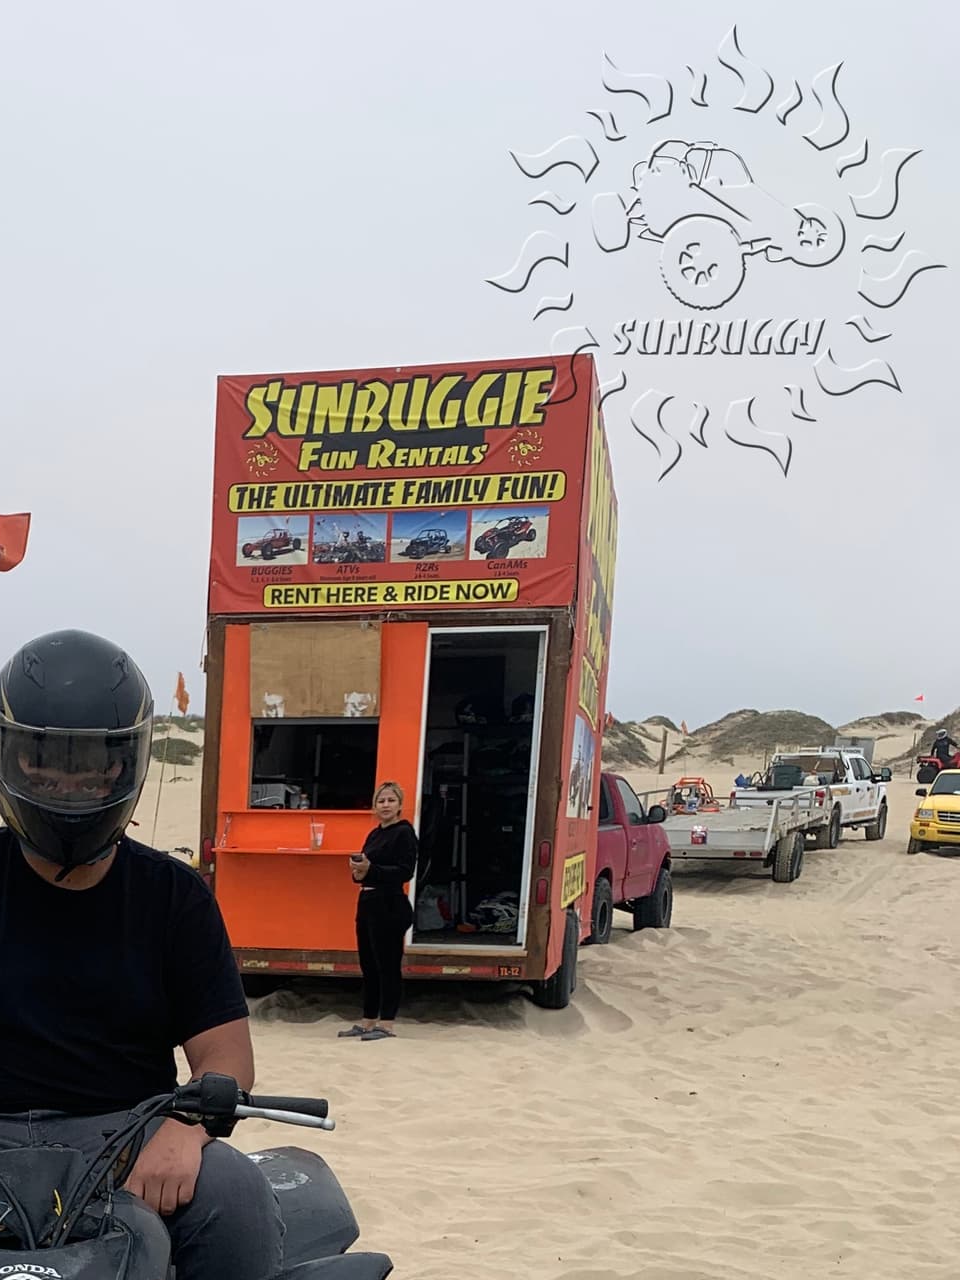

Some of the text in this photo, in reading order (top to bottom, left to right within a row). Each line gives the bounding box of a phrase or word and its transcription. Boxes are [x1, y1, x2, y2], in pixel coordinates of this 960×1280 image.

[243, 368, 555, 439] SUNBUGGIE
[298, 438, 488, 471] FUN RENTALS
[236, 473, 559, 510] THE ULTIMATE FAMILY FUN!
[250, 565, 293, 576] BUGGIES
[336, 564, 361, 575] ATVs
[487, 559, 529, 570] CanAMs
[270, 582, 513, 605] RENT HERE & RIDE NOW
